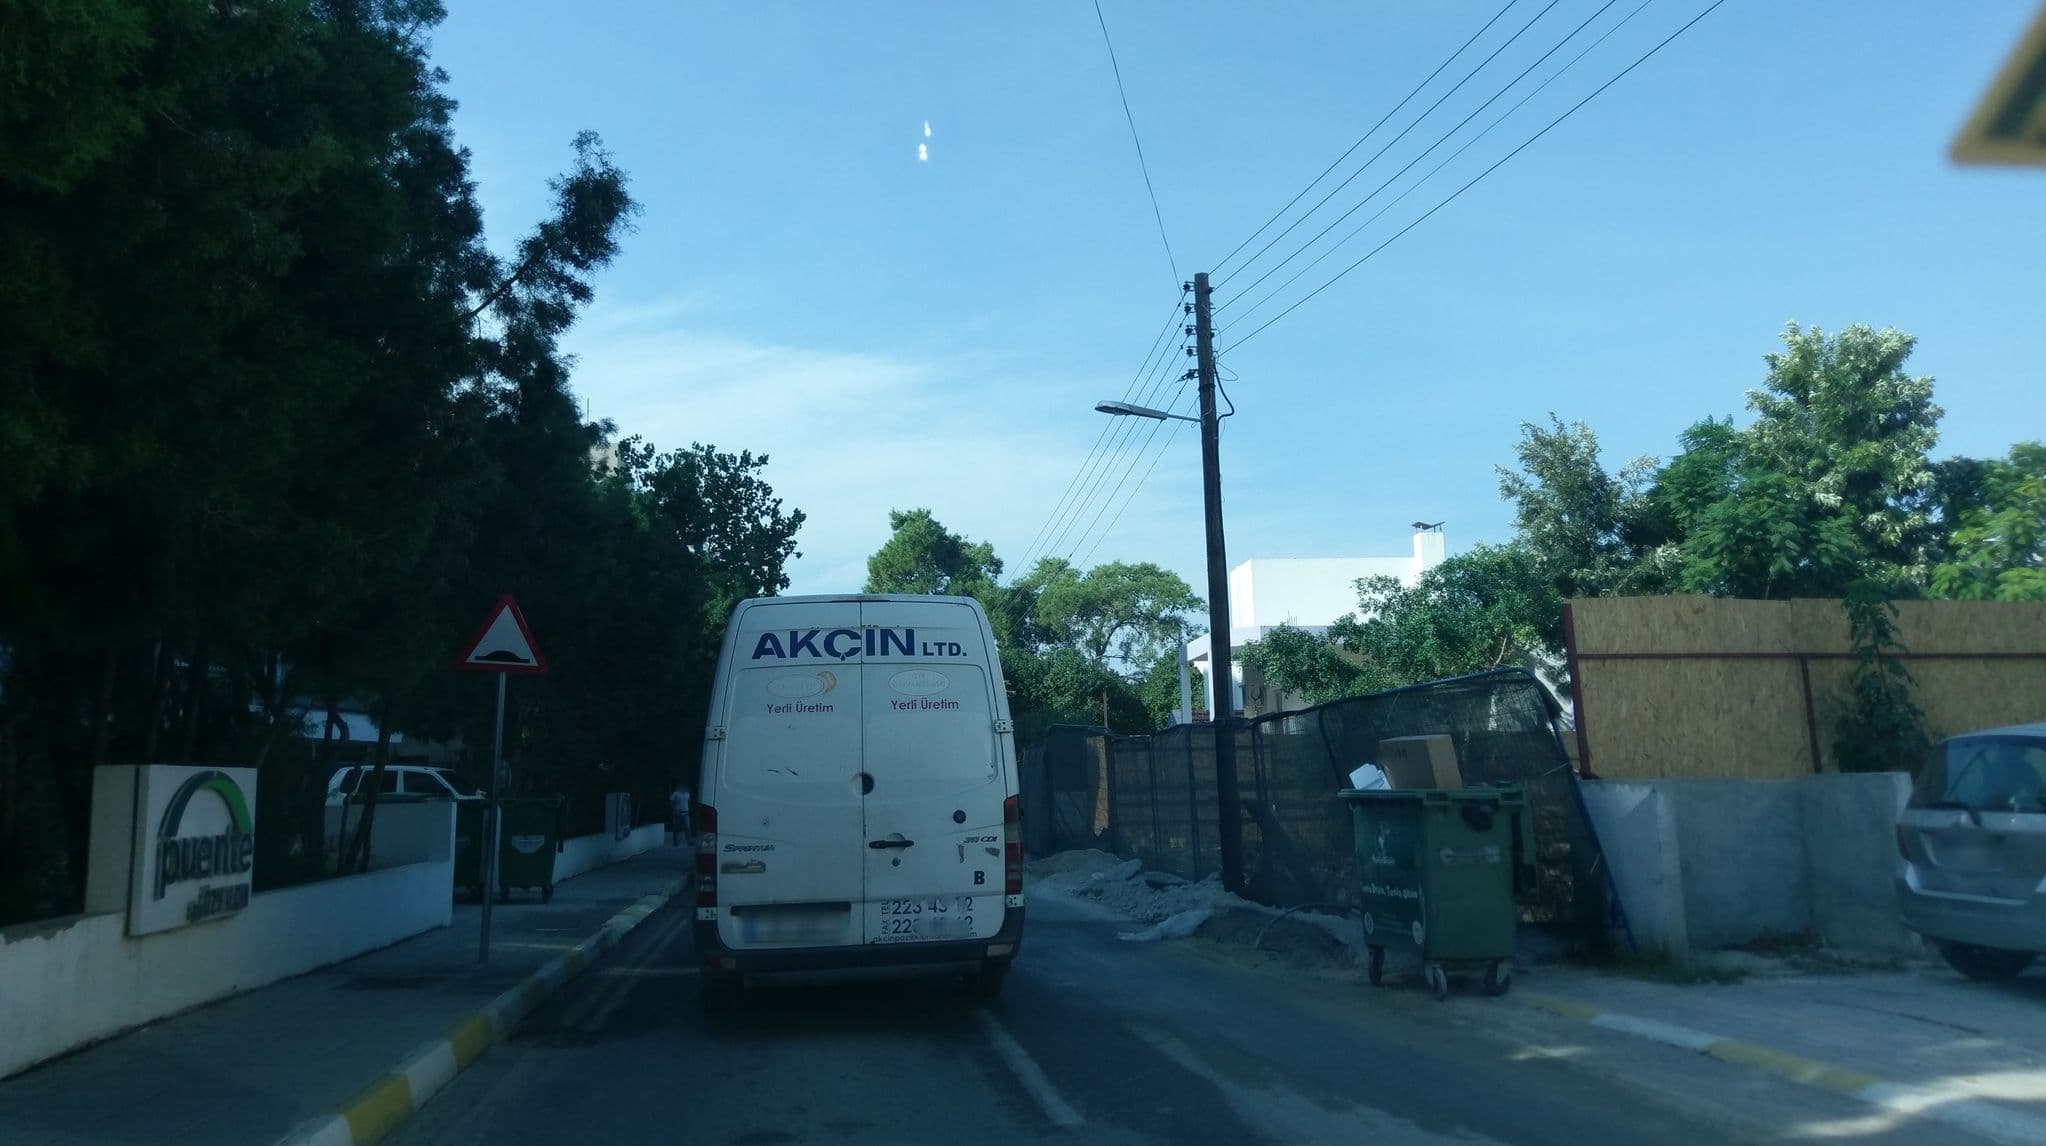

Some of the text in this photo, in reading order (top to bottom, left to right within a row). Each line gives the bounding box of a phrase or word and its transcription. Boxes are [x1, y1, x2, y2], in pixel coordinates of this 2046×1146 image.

[922, 641, 968, 657] LTD.
[766, 701, 834, 714] Yerli Üretim
[890, 697, 960, 710] Yerli Üretim
[973, 870, 985, 885] B
